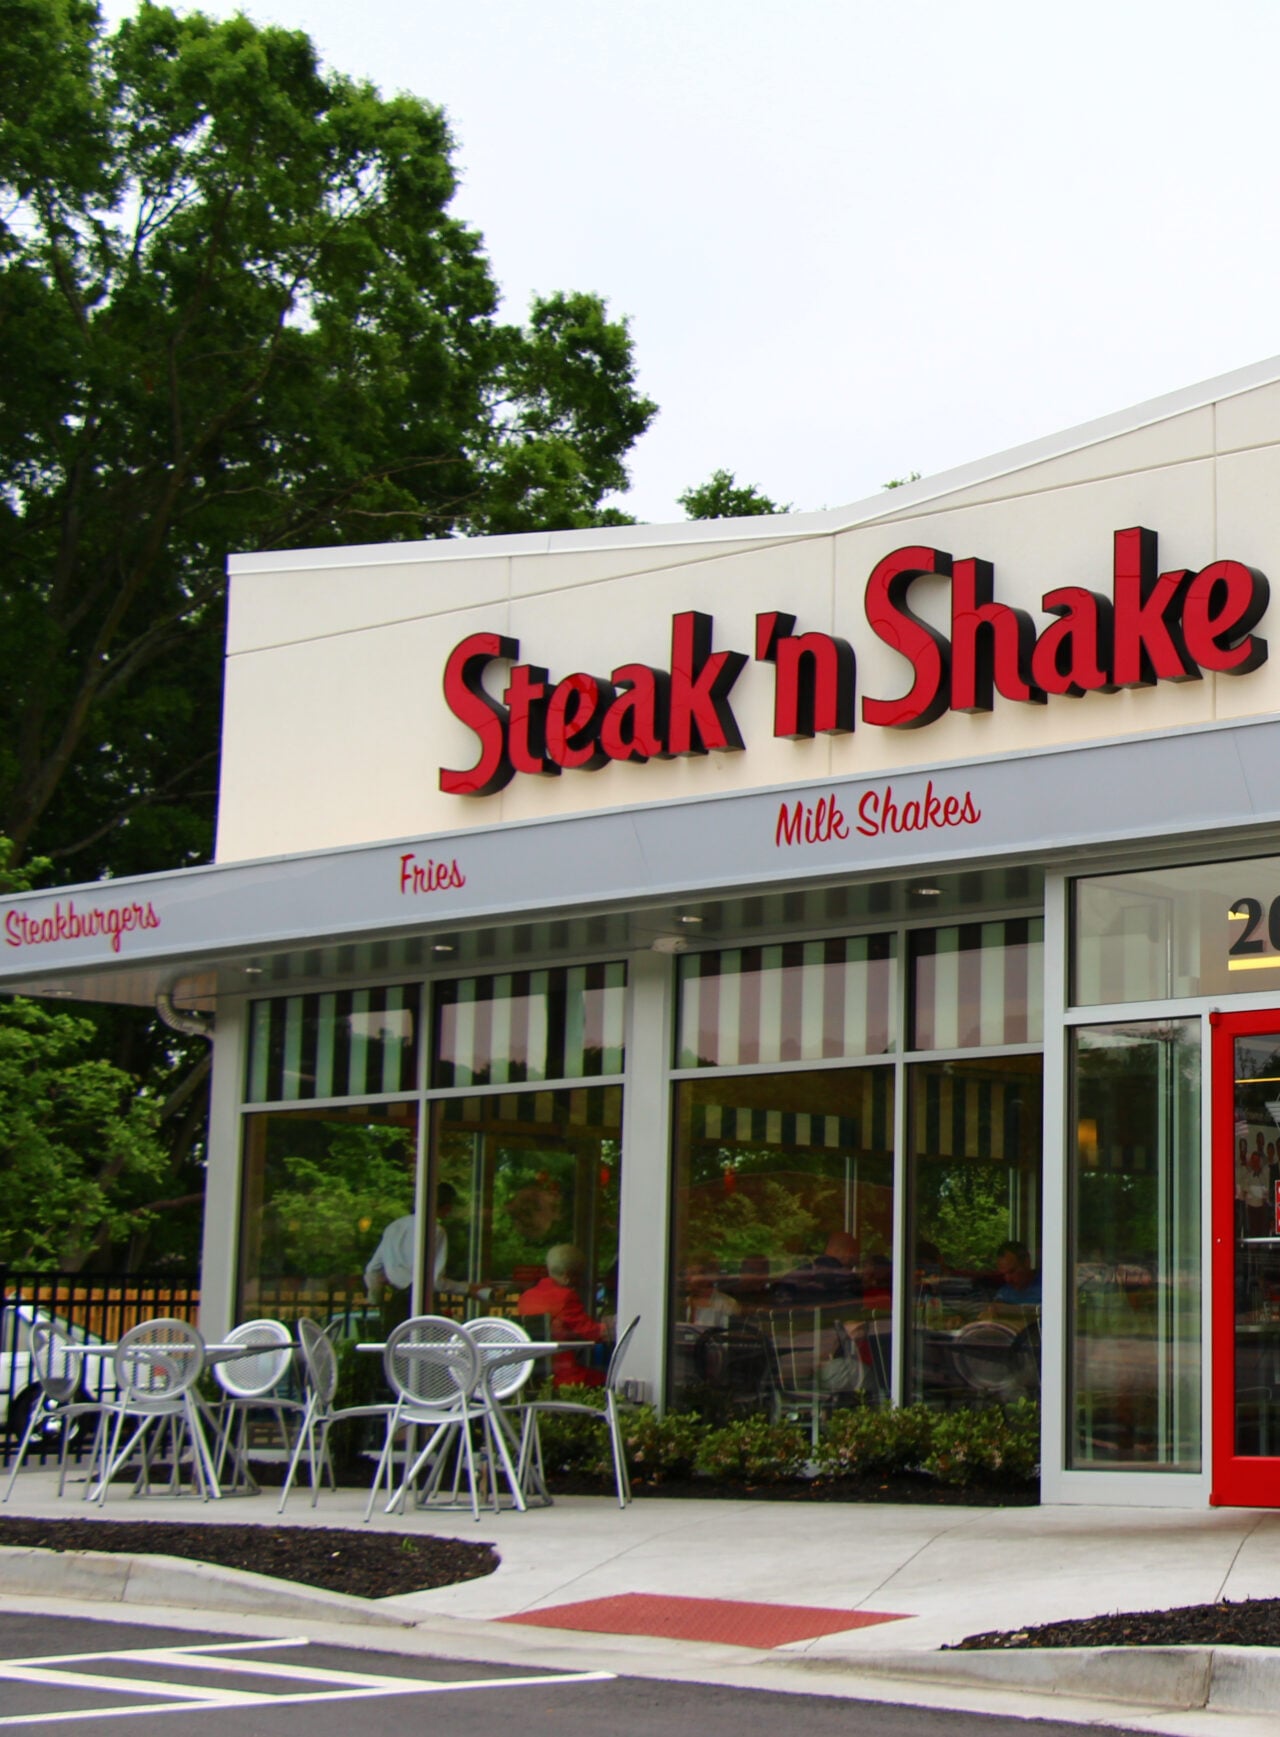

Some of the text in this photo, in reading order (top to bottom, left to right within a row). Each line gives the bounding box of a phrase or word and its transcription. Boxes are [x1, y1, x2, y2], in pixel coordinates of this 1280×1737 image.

[438, 610, 749, 797] Steak
[861, 526, 1270, 730] Shake
[775, 780, 981, 847] Milk Shakes
[400, 853, 466, 895] Fries
[5, 900, 160, 953] Steakburgers
